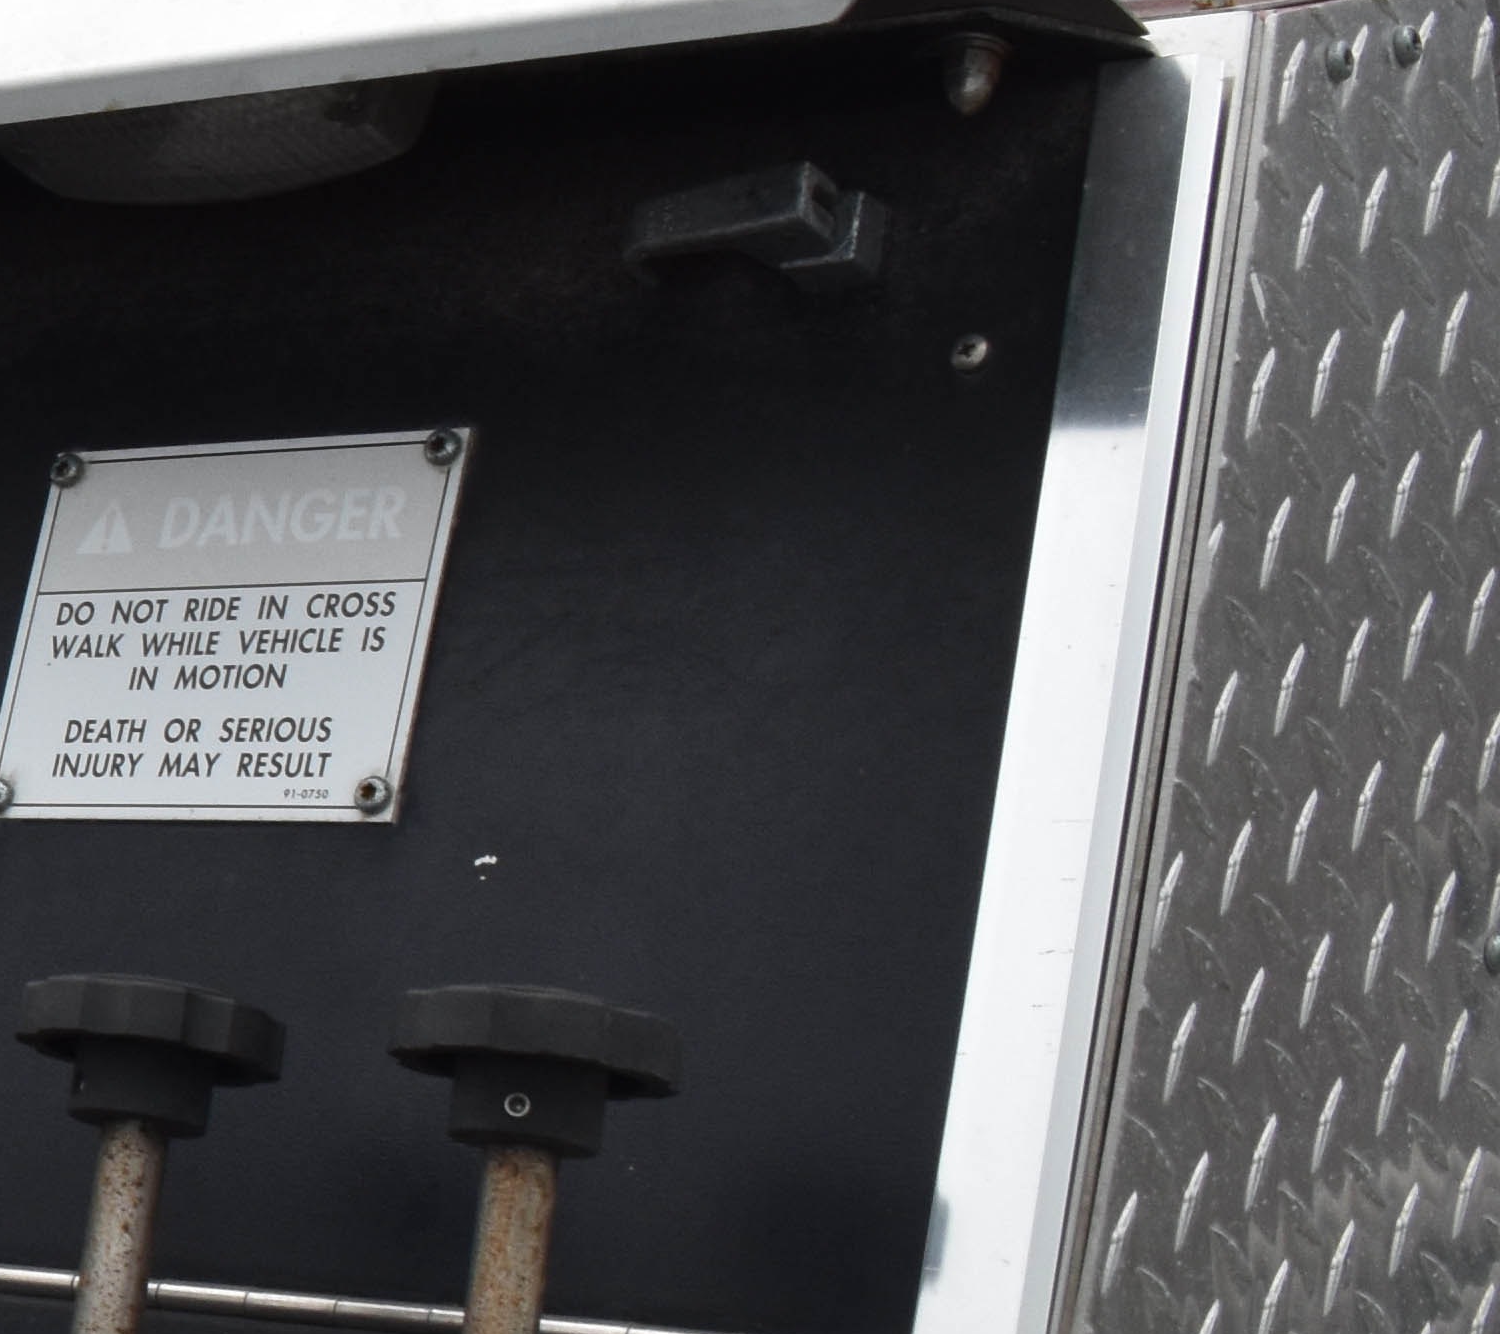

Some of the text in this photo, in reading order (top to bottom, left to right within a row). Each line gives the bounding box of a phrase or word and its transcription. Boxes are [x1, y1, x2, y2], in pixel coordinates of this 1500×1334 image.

[158, 486, 407, 550] DANGER
[56, 591, 397, 626] DO NOT RIDE IN CROSS
[51, 626, 387, 659] WALK WHILE VEHICLE IS
[129, 663, 288, 691] IN MOTION
[64, 716, 333, 744] DEATH OR SERIOUS
[52, 751, 333, 778] INJURY MAY RESULT
[283, 788, 329, 799] 91-0750
